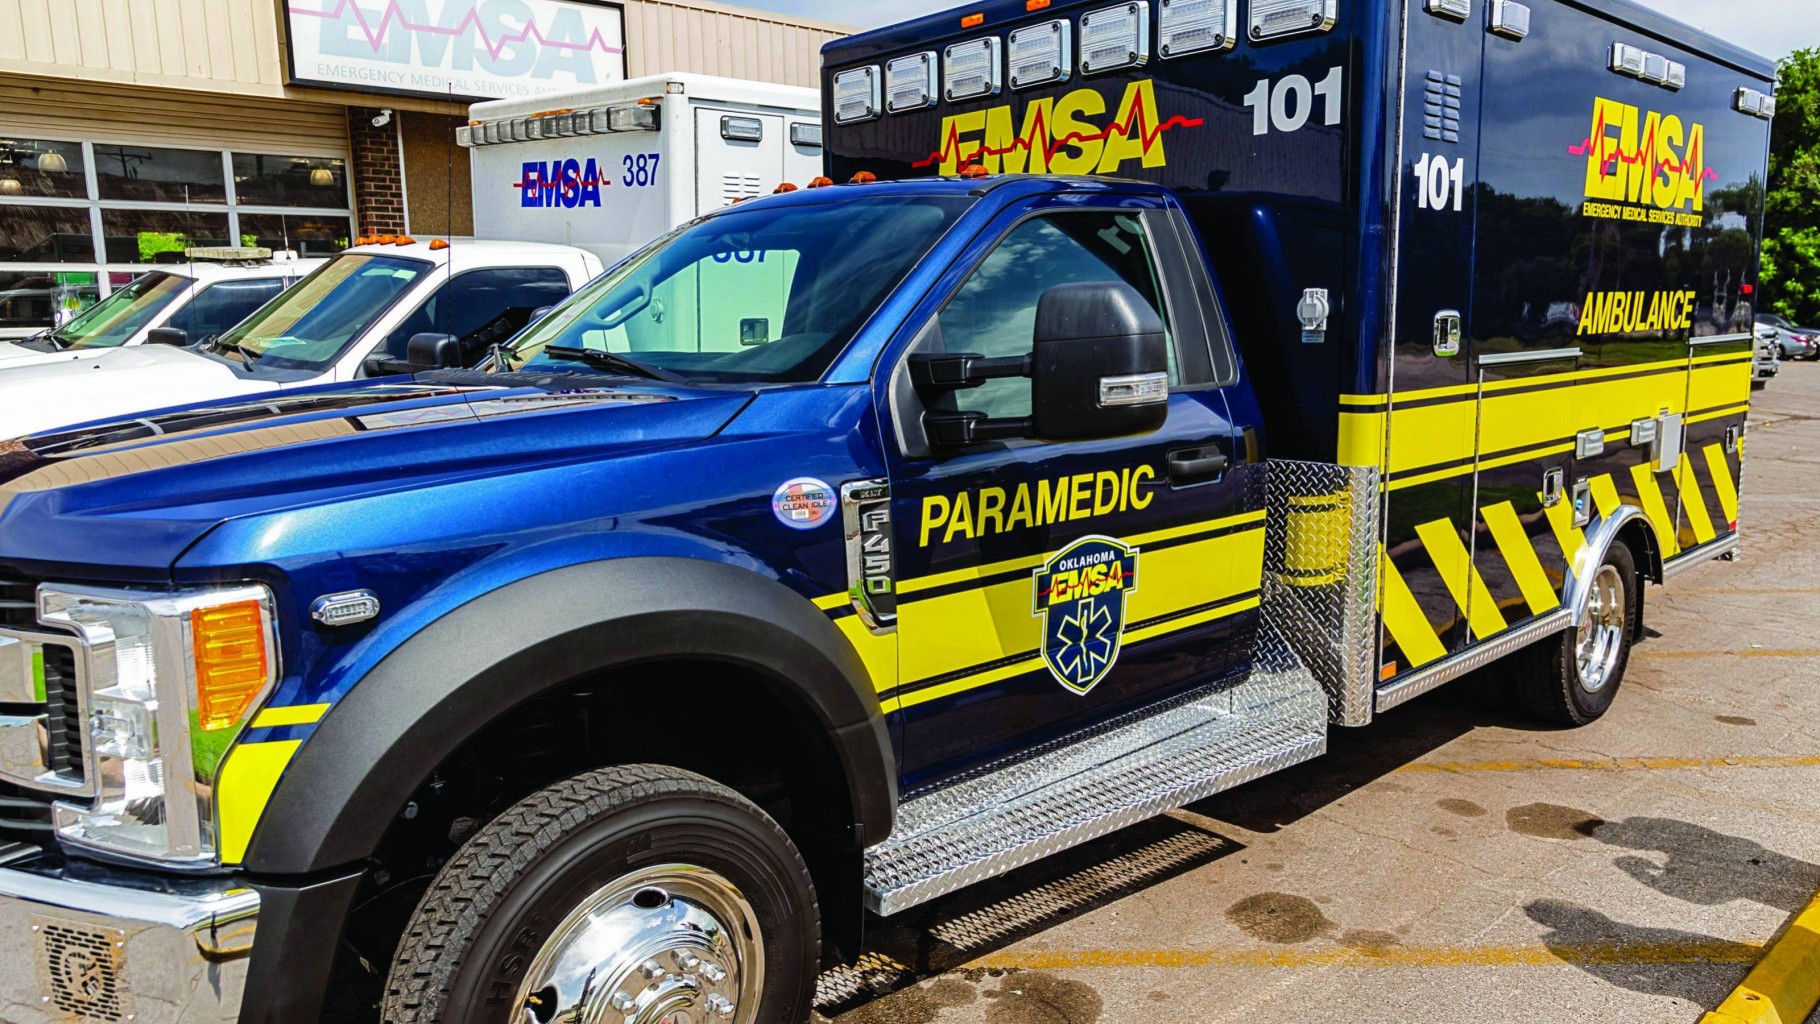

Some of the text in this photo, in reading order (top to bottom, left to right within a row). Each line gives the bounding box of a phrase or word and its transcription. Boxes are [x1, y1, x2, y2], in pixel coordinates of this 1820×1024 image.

[318, 0, 598, 85] EMSA
[317, 63, 405, 84] EMERGENCY
[411, 73, 470, 91] MEDICAL
[474, 79, 530, 97] SERVICES
[1243, 65, 1342, 136] 101
[939, 78, 1166, 176] EMSA
[622, 153, 660, 187] 387
[1584, 96, 1704, 212] EMSA
[521, 158, 602, 209] EMSA
[1414, 152, 1464, 211] 101
[1583, 201, 1703, 228] EMERGENCY MEDICAL SERVICES AUTHORITY
[1576, 289, 1696, 336] AMBULANCE
[782, 500, 828, 512] CLEAN IDLE
[785, 492, 824, 502] CERTIFIED
[919, 464, 1155, 548] PARAMEDIC
[1048, 560, 1123, 606] EMSA
[1059, 550, 1115, 571] OKLAHOMA
